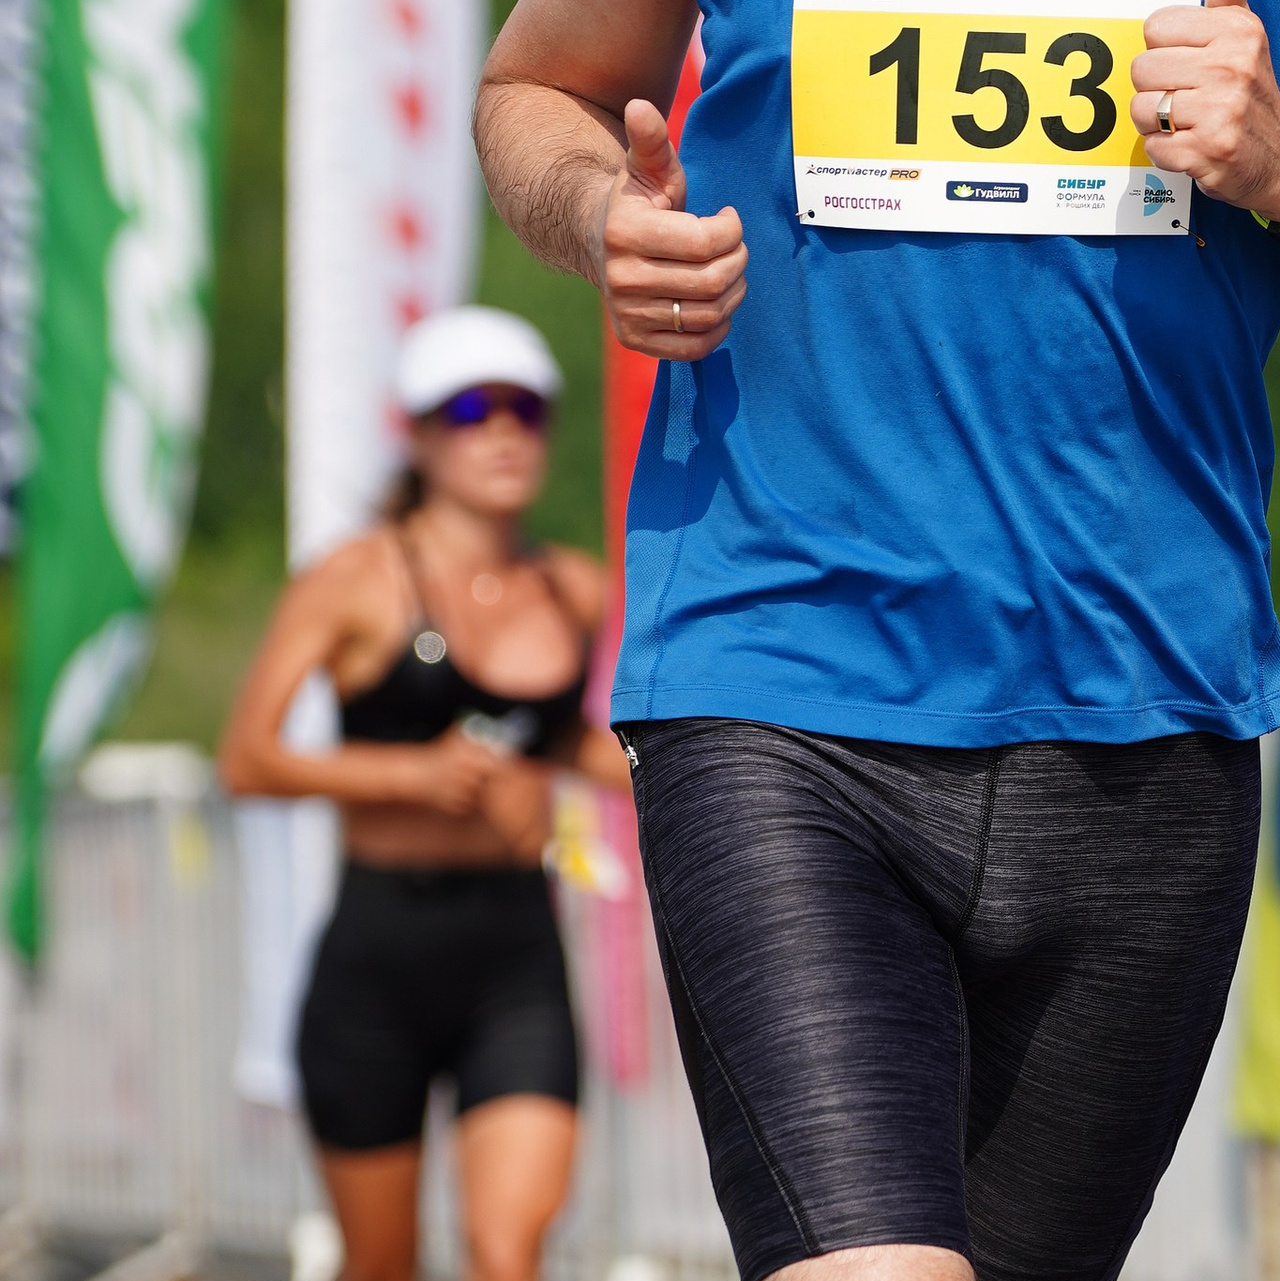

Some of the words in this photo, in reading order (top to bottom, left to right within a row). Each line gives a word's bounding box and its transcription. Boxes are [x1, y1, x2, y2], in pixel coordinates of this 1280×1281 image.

[868, 27, 1117, 151] 153
[889, 169, 920, 179] PRO
[1057, 178, 1106, 190] СИБУР
[1056, 192, 1105, 201] ФОРМУЛА
[1144, 189, 1173, 197] РАДИО
[824, 195, 902, 211] РОСГОССТРАХ
[1143, 196, 1176, 204] СИБИРЬ
